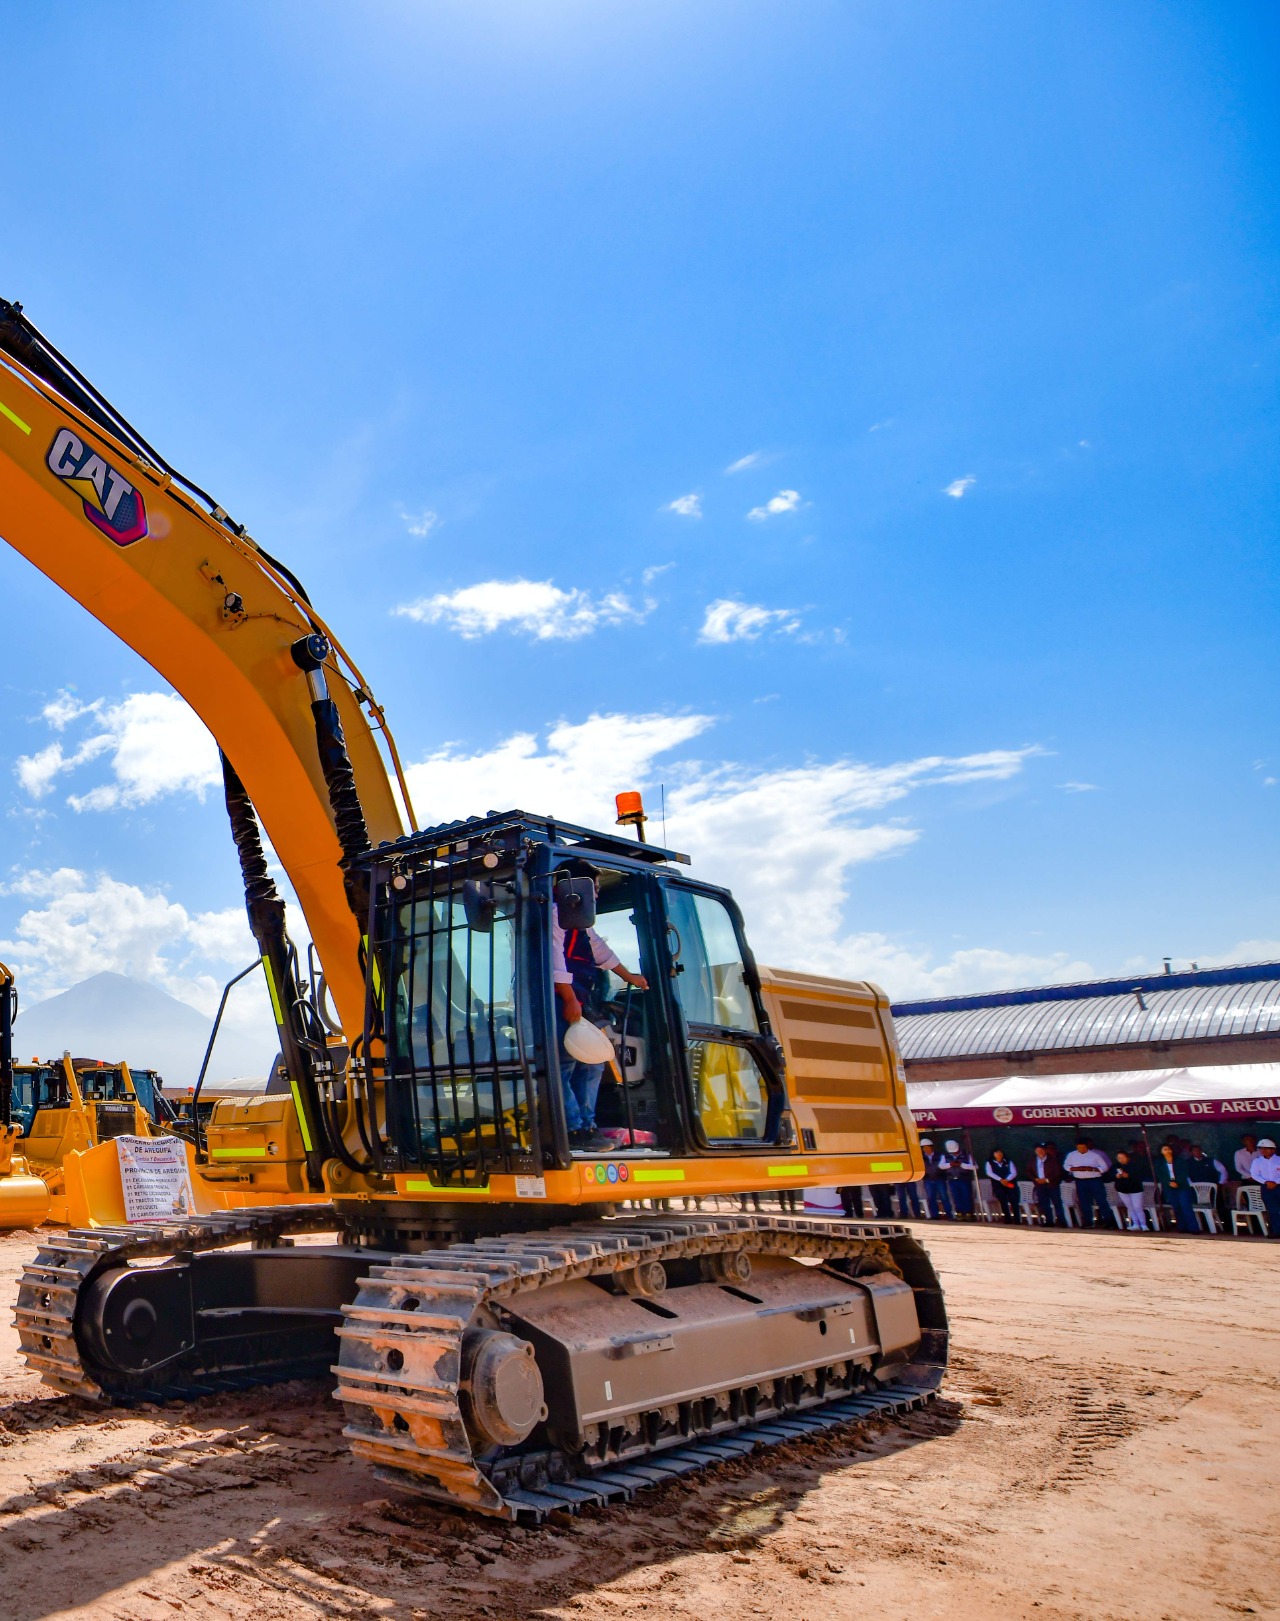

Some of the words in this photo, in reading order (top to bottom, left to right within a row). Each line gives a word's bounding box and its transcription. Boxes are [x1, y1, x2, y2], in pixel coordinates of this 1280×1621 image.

[48, 429, 133, 520] CAT
[1022, 1107, 1097, 1119] GOBIERNO
[1102, 1103, 1185, 1117] REGIONAL
[1190, 1102, 1215, 1114] DE
